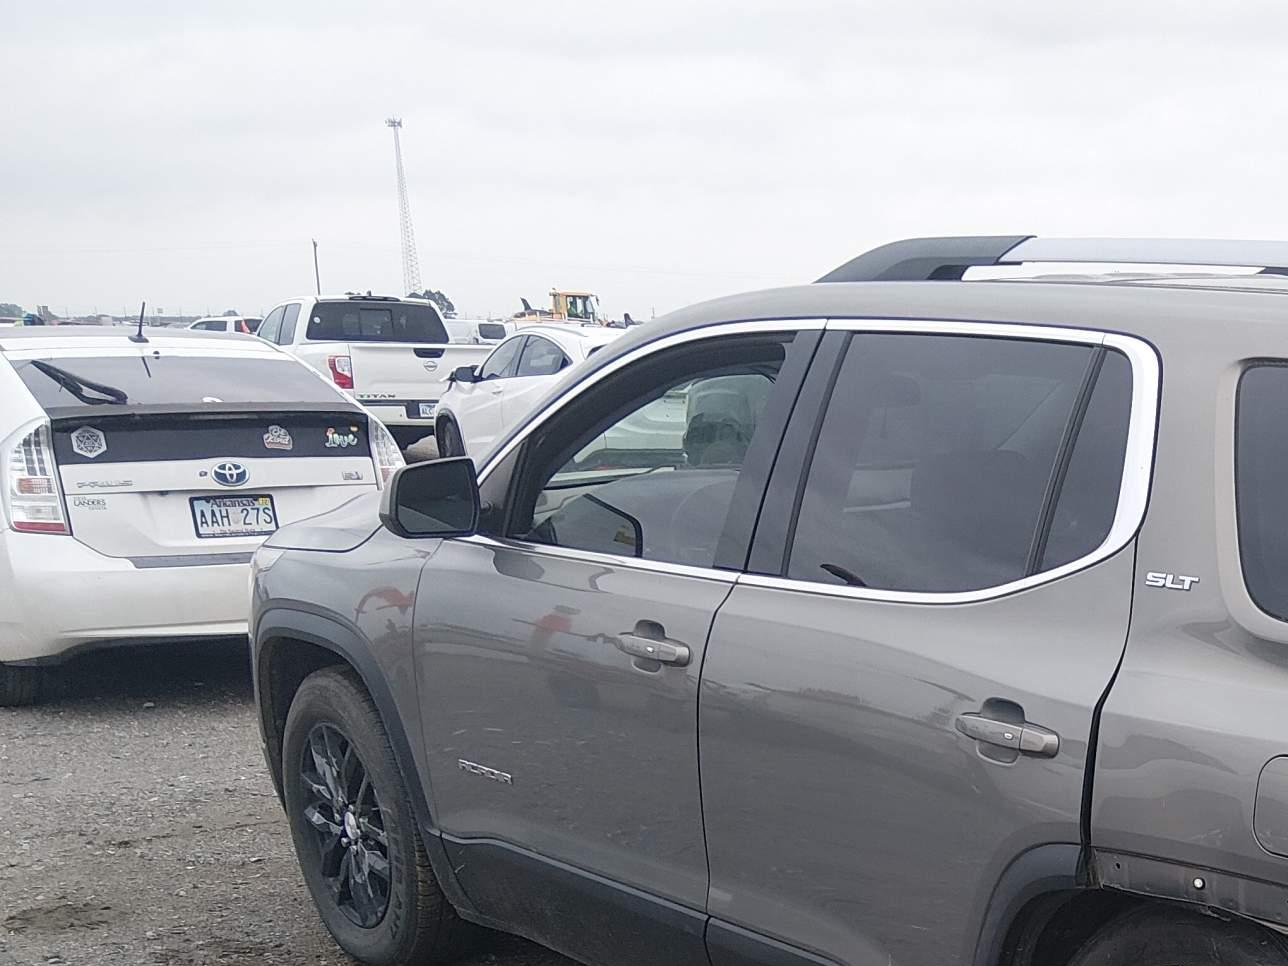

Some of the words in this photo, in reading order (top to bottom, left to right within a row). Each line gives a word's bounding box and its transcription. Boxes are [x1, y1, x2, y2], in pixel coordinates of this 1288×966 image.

[200, 509, 231, 527] AAH
[240, 507, 273, 526] 27S
[1145, 572, 1199, 590] SLT
